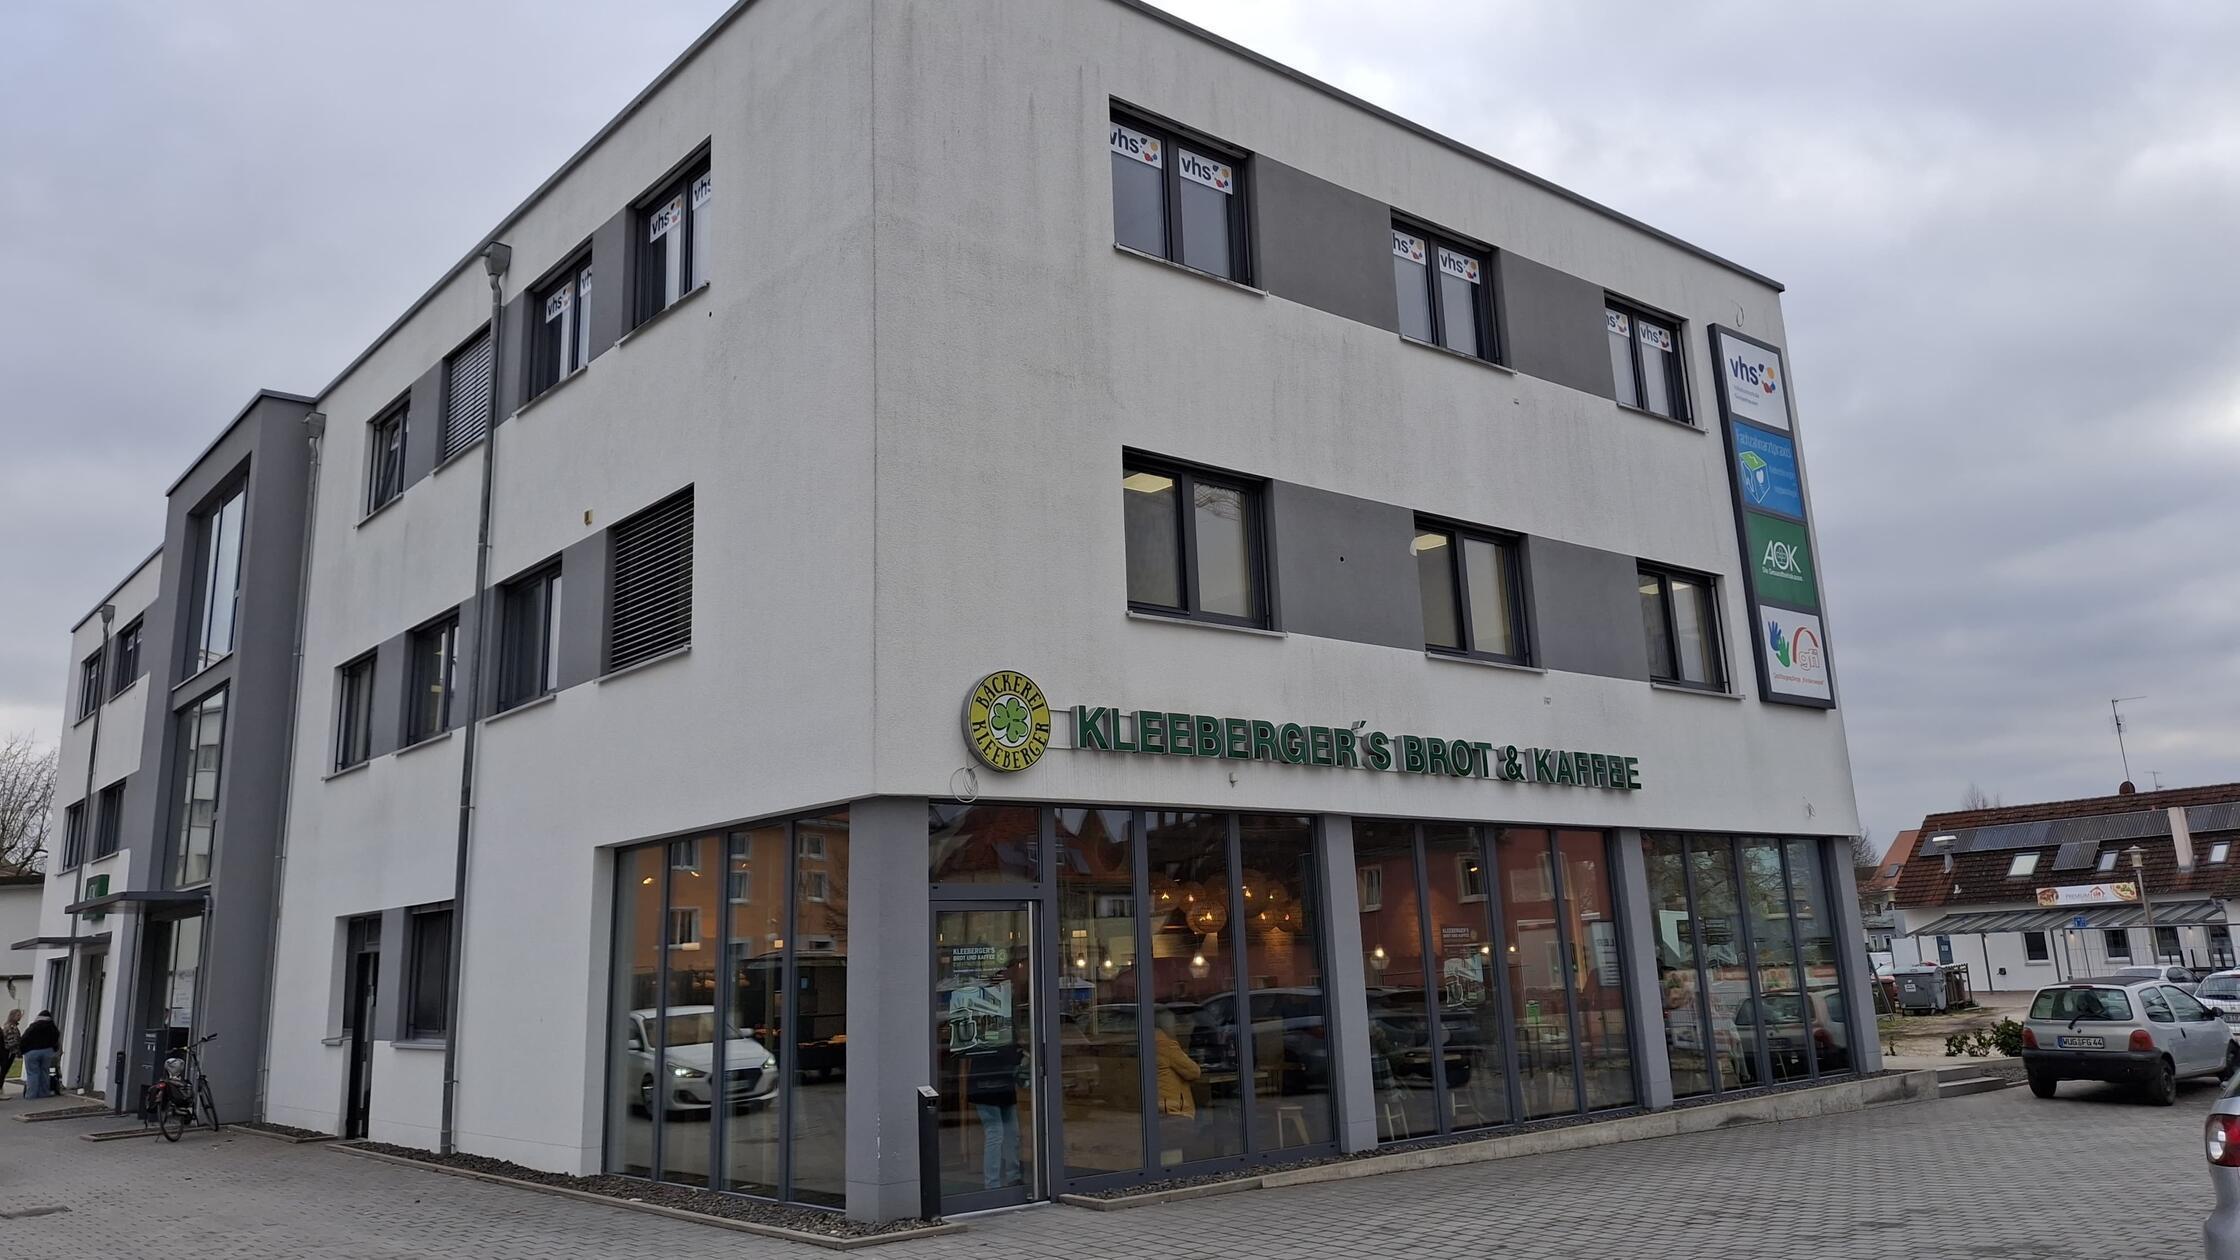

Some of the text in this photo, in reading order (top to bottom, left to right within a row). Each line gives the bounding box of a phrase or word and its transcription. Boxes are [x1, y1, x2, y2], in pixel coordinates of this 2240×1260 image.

[1181, 156, 1211, 181] vhs
[652, 211, 670, 235] vhs
[1392, 232, 1409, 254] hs
[1440, 252, 1464, 273] vhs
[547, 296, 562, 316] vhs
[1640, 325, 1659, 343] vhs
[1730, 355, 1758, 386] vhs
[1763, 540, 1801, 573] AOK
[972, 719, 1049, 769] KLEEBERGER
[1399, 735, 1492, 777] BROT
[1501, 745, 1525, 780] &
[1530, 748, 1642, 789] KAFFEE
